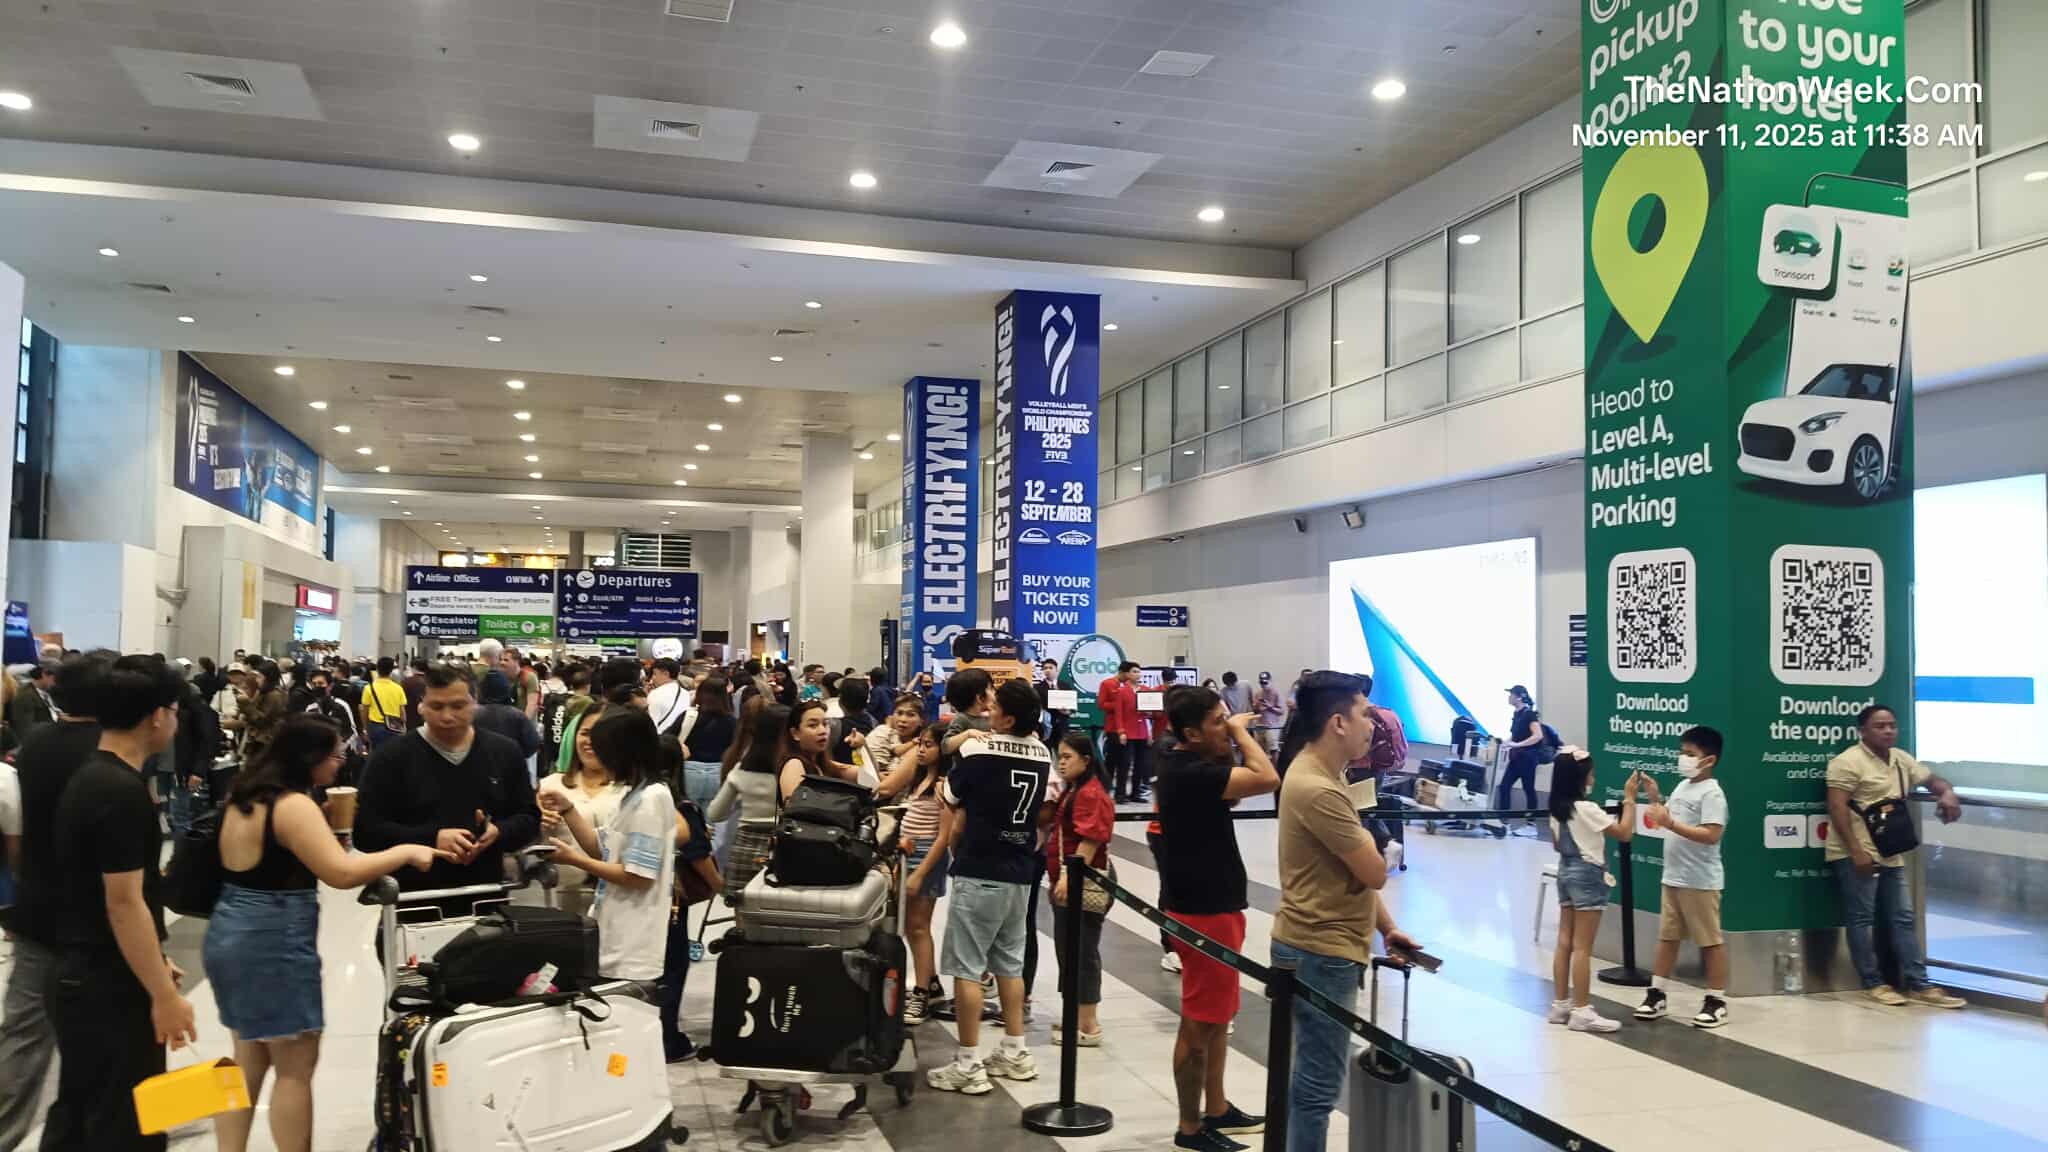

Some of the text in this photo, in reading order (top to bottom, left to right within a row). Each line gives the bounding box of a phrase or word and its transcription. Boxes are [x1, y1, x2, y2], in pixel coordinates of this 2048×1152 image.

[1589, 0, 1699, 91] pickup
[1739, 9, 1897, 69] to your
[1773, 268, 1816, 281] Transport
[1591, 378, 1674, 418] Head to
[1024, 415, 1090, 434] PHILIPPINES
[1042, 432, 1072, 450] 2025
[1591, 415, 1674, 455] Level A,
[993, 304, 1013, 601] ELECTRIFYING!
[1591, 442, 1713, 492] Multi-level
[923, 384, 969, 613] ELECTRIFYING!
[1024, 479, 1045, 502] 12
[1062, 481, 1084, 504] 28
[1021, 503, 1092, 523] SEPTEMBER
[1591, 494, 1676, 529] Parking
[425, 573, 481, 583] Airline Offices
[599, 574, 672, 589] Departures
[1022, 574, 1091, 588] BUY YOUR
[1023, 591, 1090, 607] TICKETS
[431, 616, 478, 625] Escalator
[485, 619, 519, 630] Toilets
[1033, 610, 1079, 625] NOW!
[431, 626, 478, 635] Elevators
[1074, 656, 1119, 674] Grab
[1616, 692, 1689, 713] Download
[552, 704, 566, 744] adidas
[1609, 715, 1633, 733] the
[1634, 719, 1664, 740] app
[1769, 719, 1802, 740] the
[1805, 724, 1843, 745] app
[987, 740, 1030, 756] STREET
[1762, 751, 1809, 763] Available
[1786, 767, 1808, 779] and
[1011, 769, 1039, 824] 7
[1774, 825, 1798, 837] VISA
